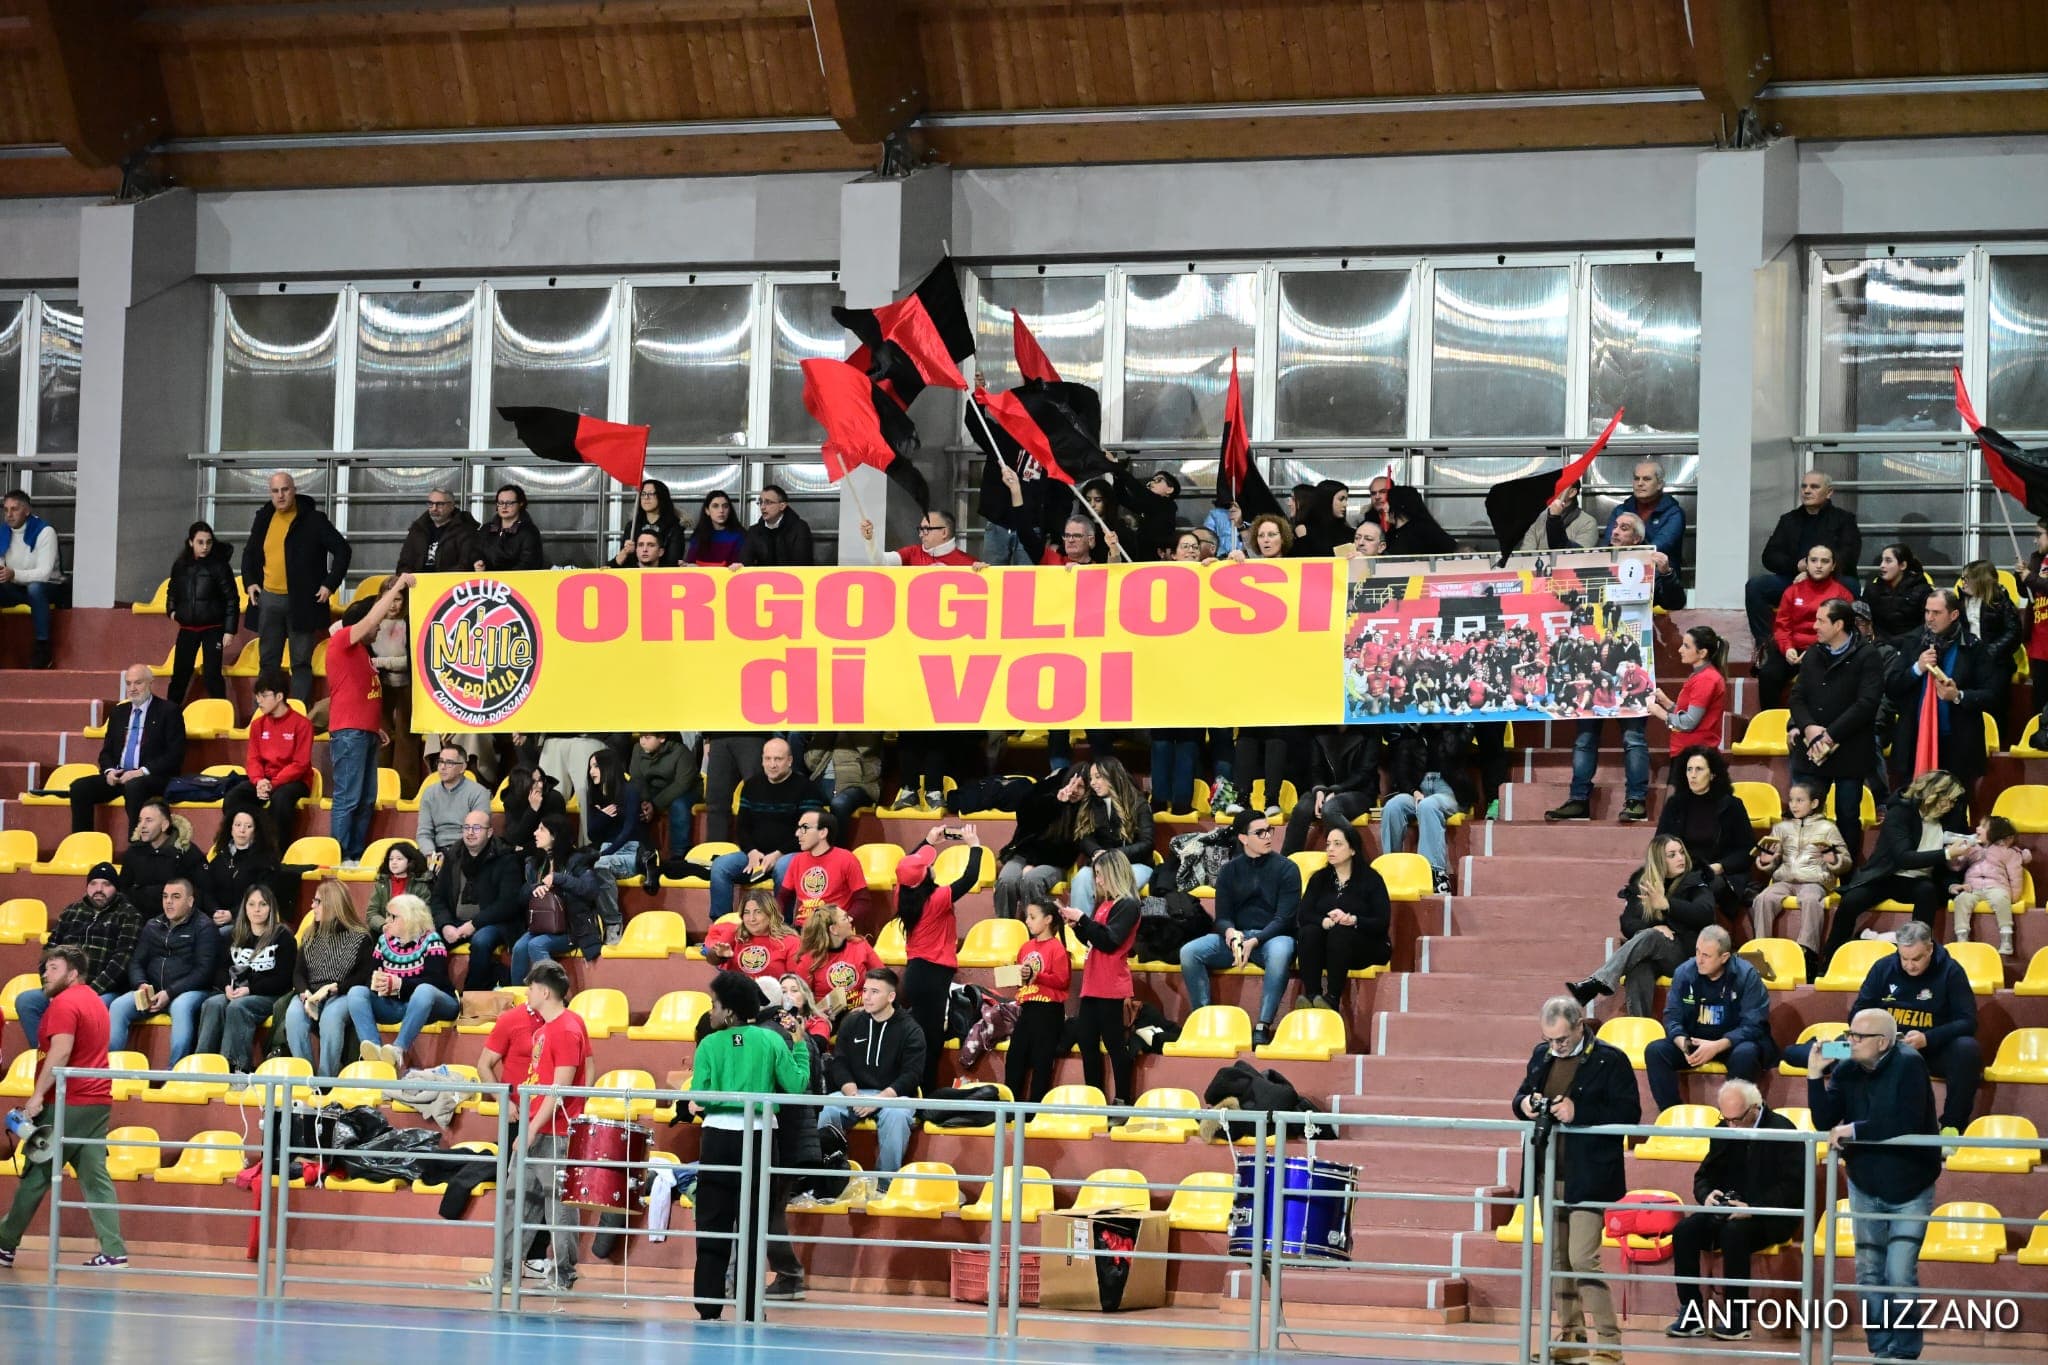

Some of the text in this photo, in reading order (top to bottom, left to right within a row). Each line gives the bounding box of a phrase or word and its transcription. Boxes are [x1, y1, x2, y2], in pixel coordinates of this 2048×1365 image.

[452, 579, 511, 606] CLUB
[556, 563, 1333, 643] ORGOGLIOSI
[431, 619, 533, 670] Mille
[439, 669, 461, 692] del
[741, 647, 1132, 724] di VOI
